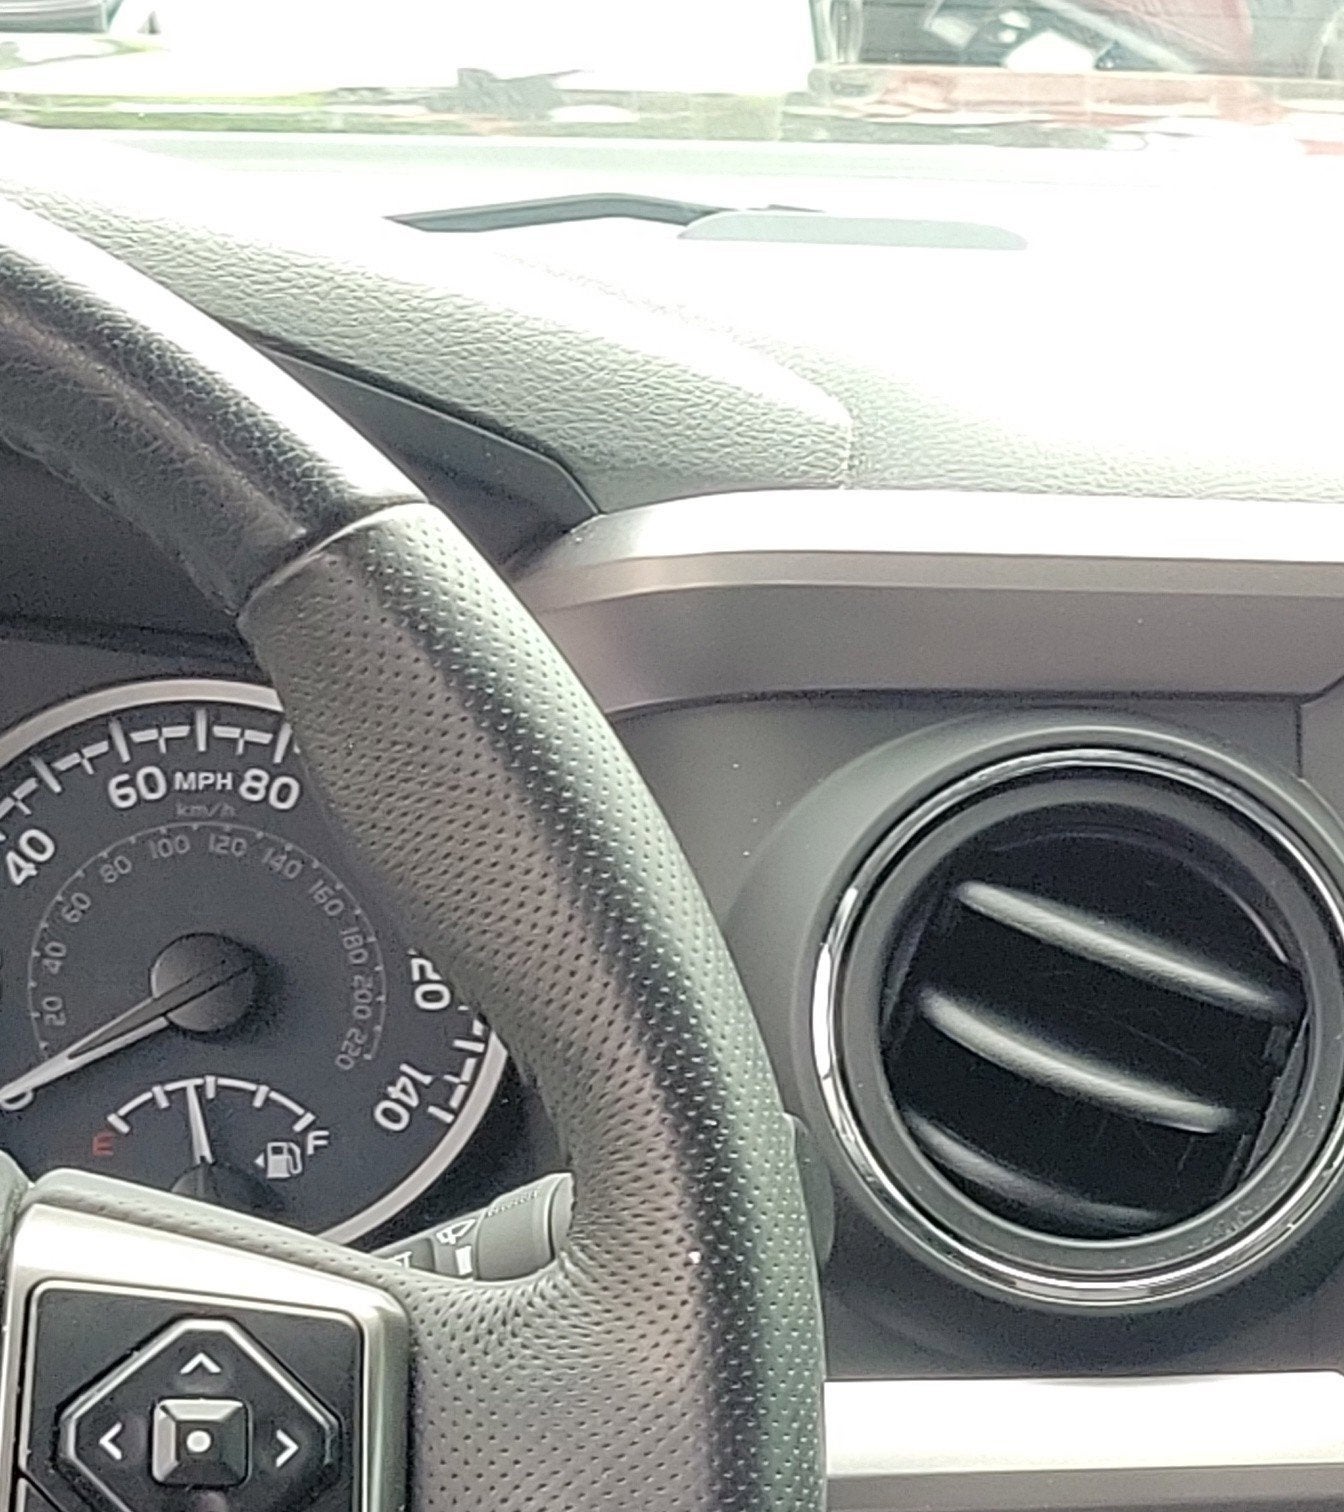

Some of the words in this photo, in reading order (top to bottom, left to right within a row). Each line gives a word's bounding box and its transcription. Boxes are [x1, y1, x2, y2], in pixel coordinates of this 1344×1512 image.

[107, 765, 168, 810] 60
[173, 770, 234, 792] MPH
[238, 767, 301, 811] 80
[5, 828, 56, 886] 40
[150, 834, 191, 859] 100
[208, 833, 248, 857] 120
[100, 856, 133, 884] 80
[262, 848, 303, 880] 140
[60, 892, 92, 924] 60
[309, 879, 344, 917] 160
[41, 941, 68, 975] 40
[340, 926, 369, 965] 180
[41, 996, 67, 1027] 20
[352, 974, 374, 1020] 200
[334, 1027, 369, 1071] 220
[374, 1062, 433, 1131] 140
[91, 1132, 116, 1157] E
[306, 1130, 330, 1155] F
